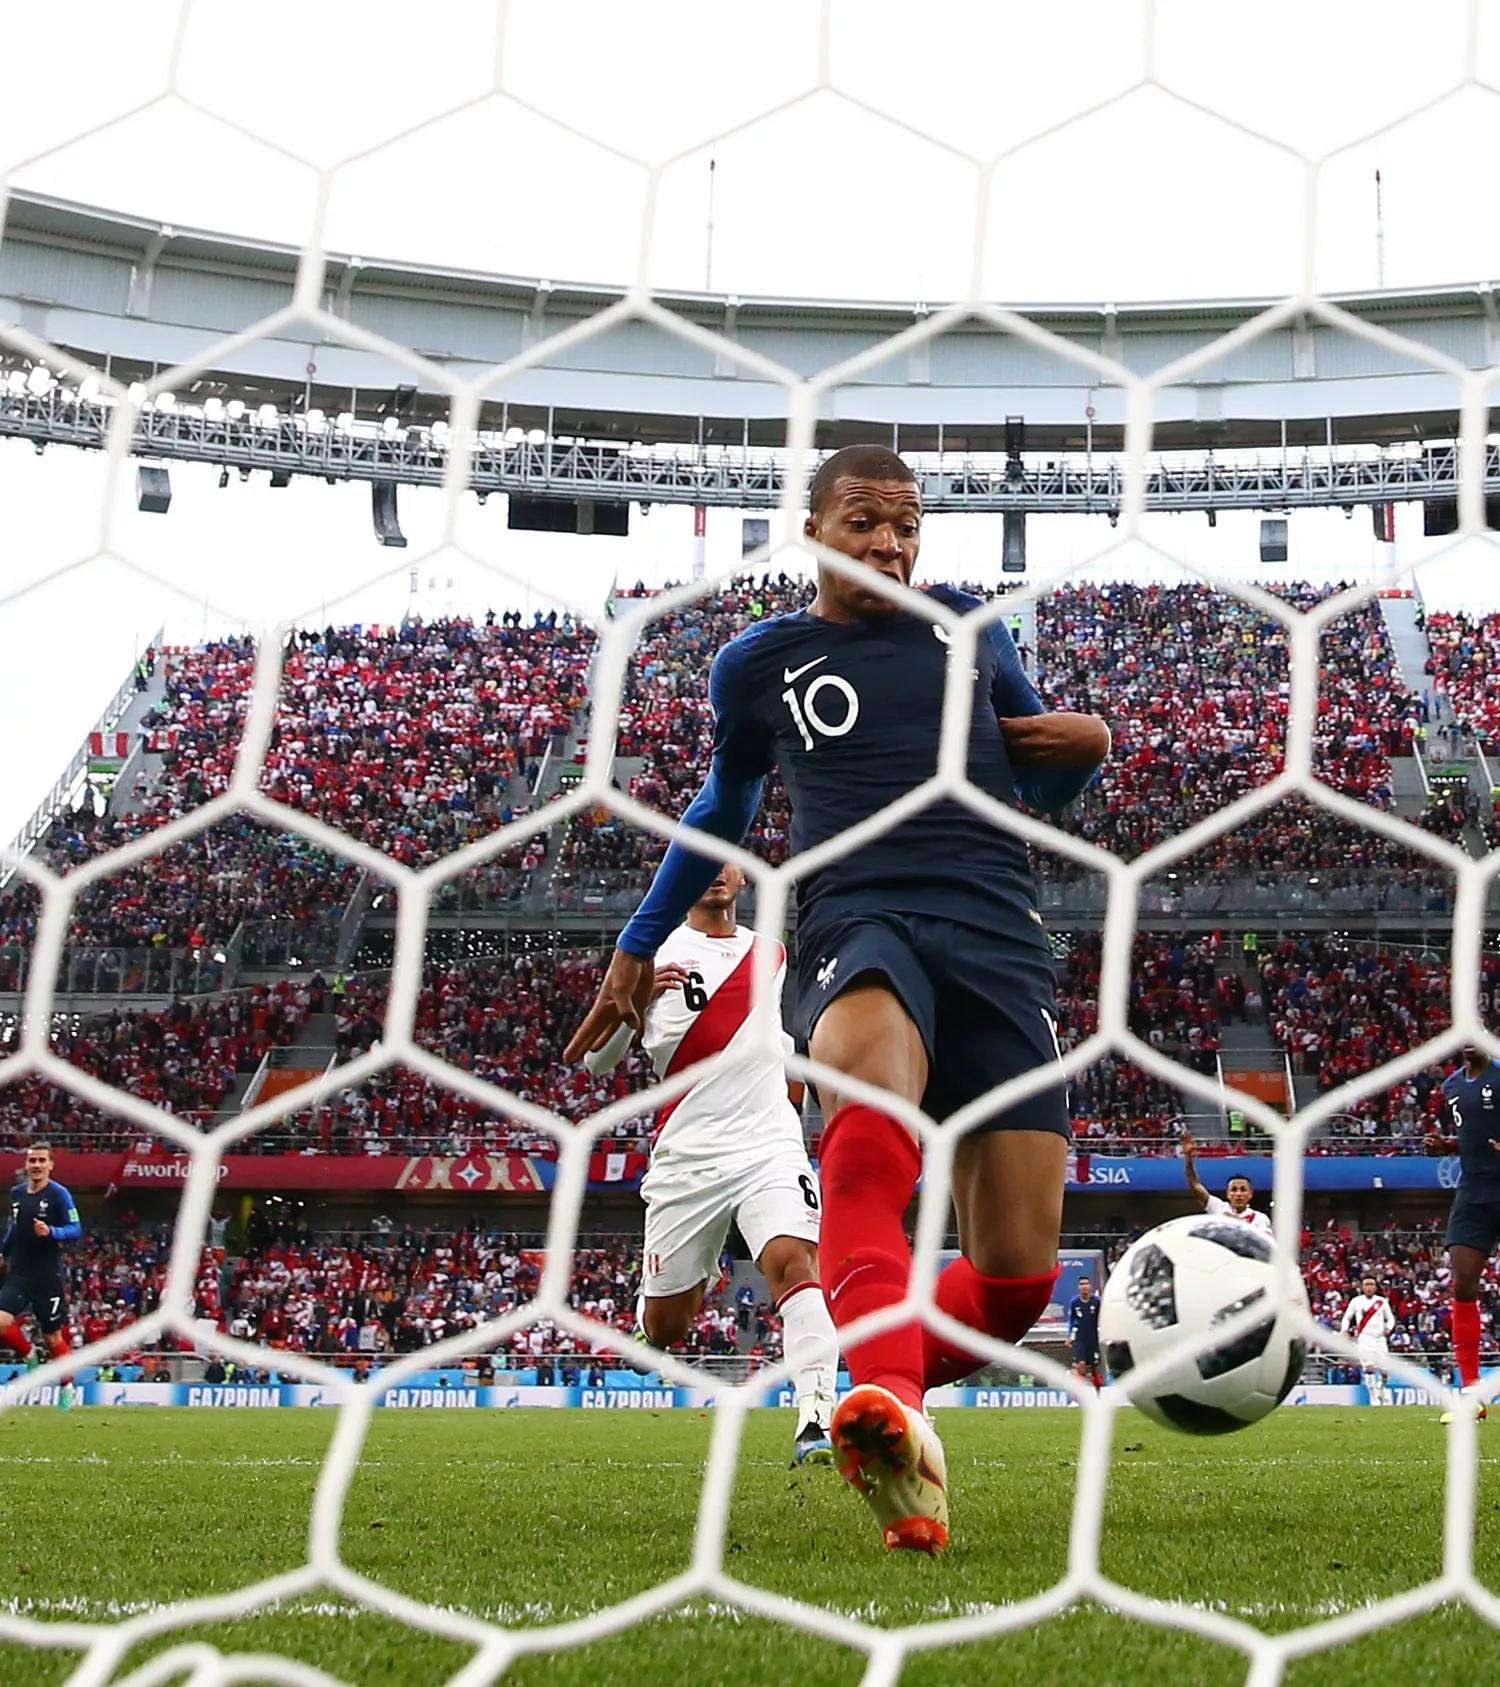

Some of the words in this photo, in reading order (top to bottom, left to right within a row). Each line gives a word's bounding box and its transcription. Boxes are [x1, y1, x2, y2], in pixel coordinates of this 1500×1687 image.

[782, 674, 859, 751] 10
[683, 971, 708, 1012] 6
[1452, 1104, 1463, 1128] 6
[123, 1160, 229, 1182] #worldp
[50, 1296, 61, 1315] 7
